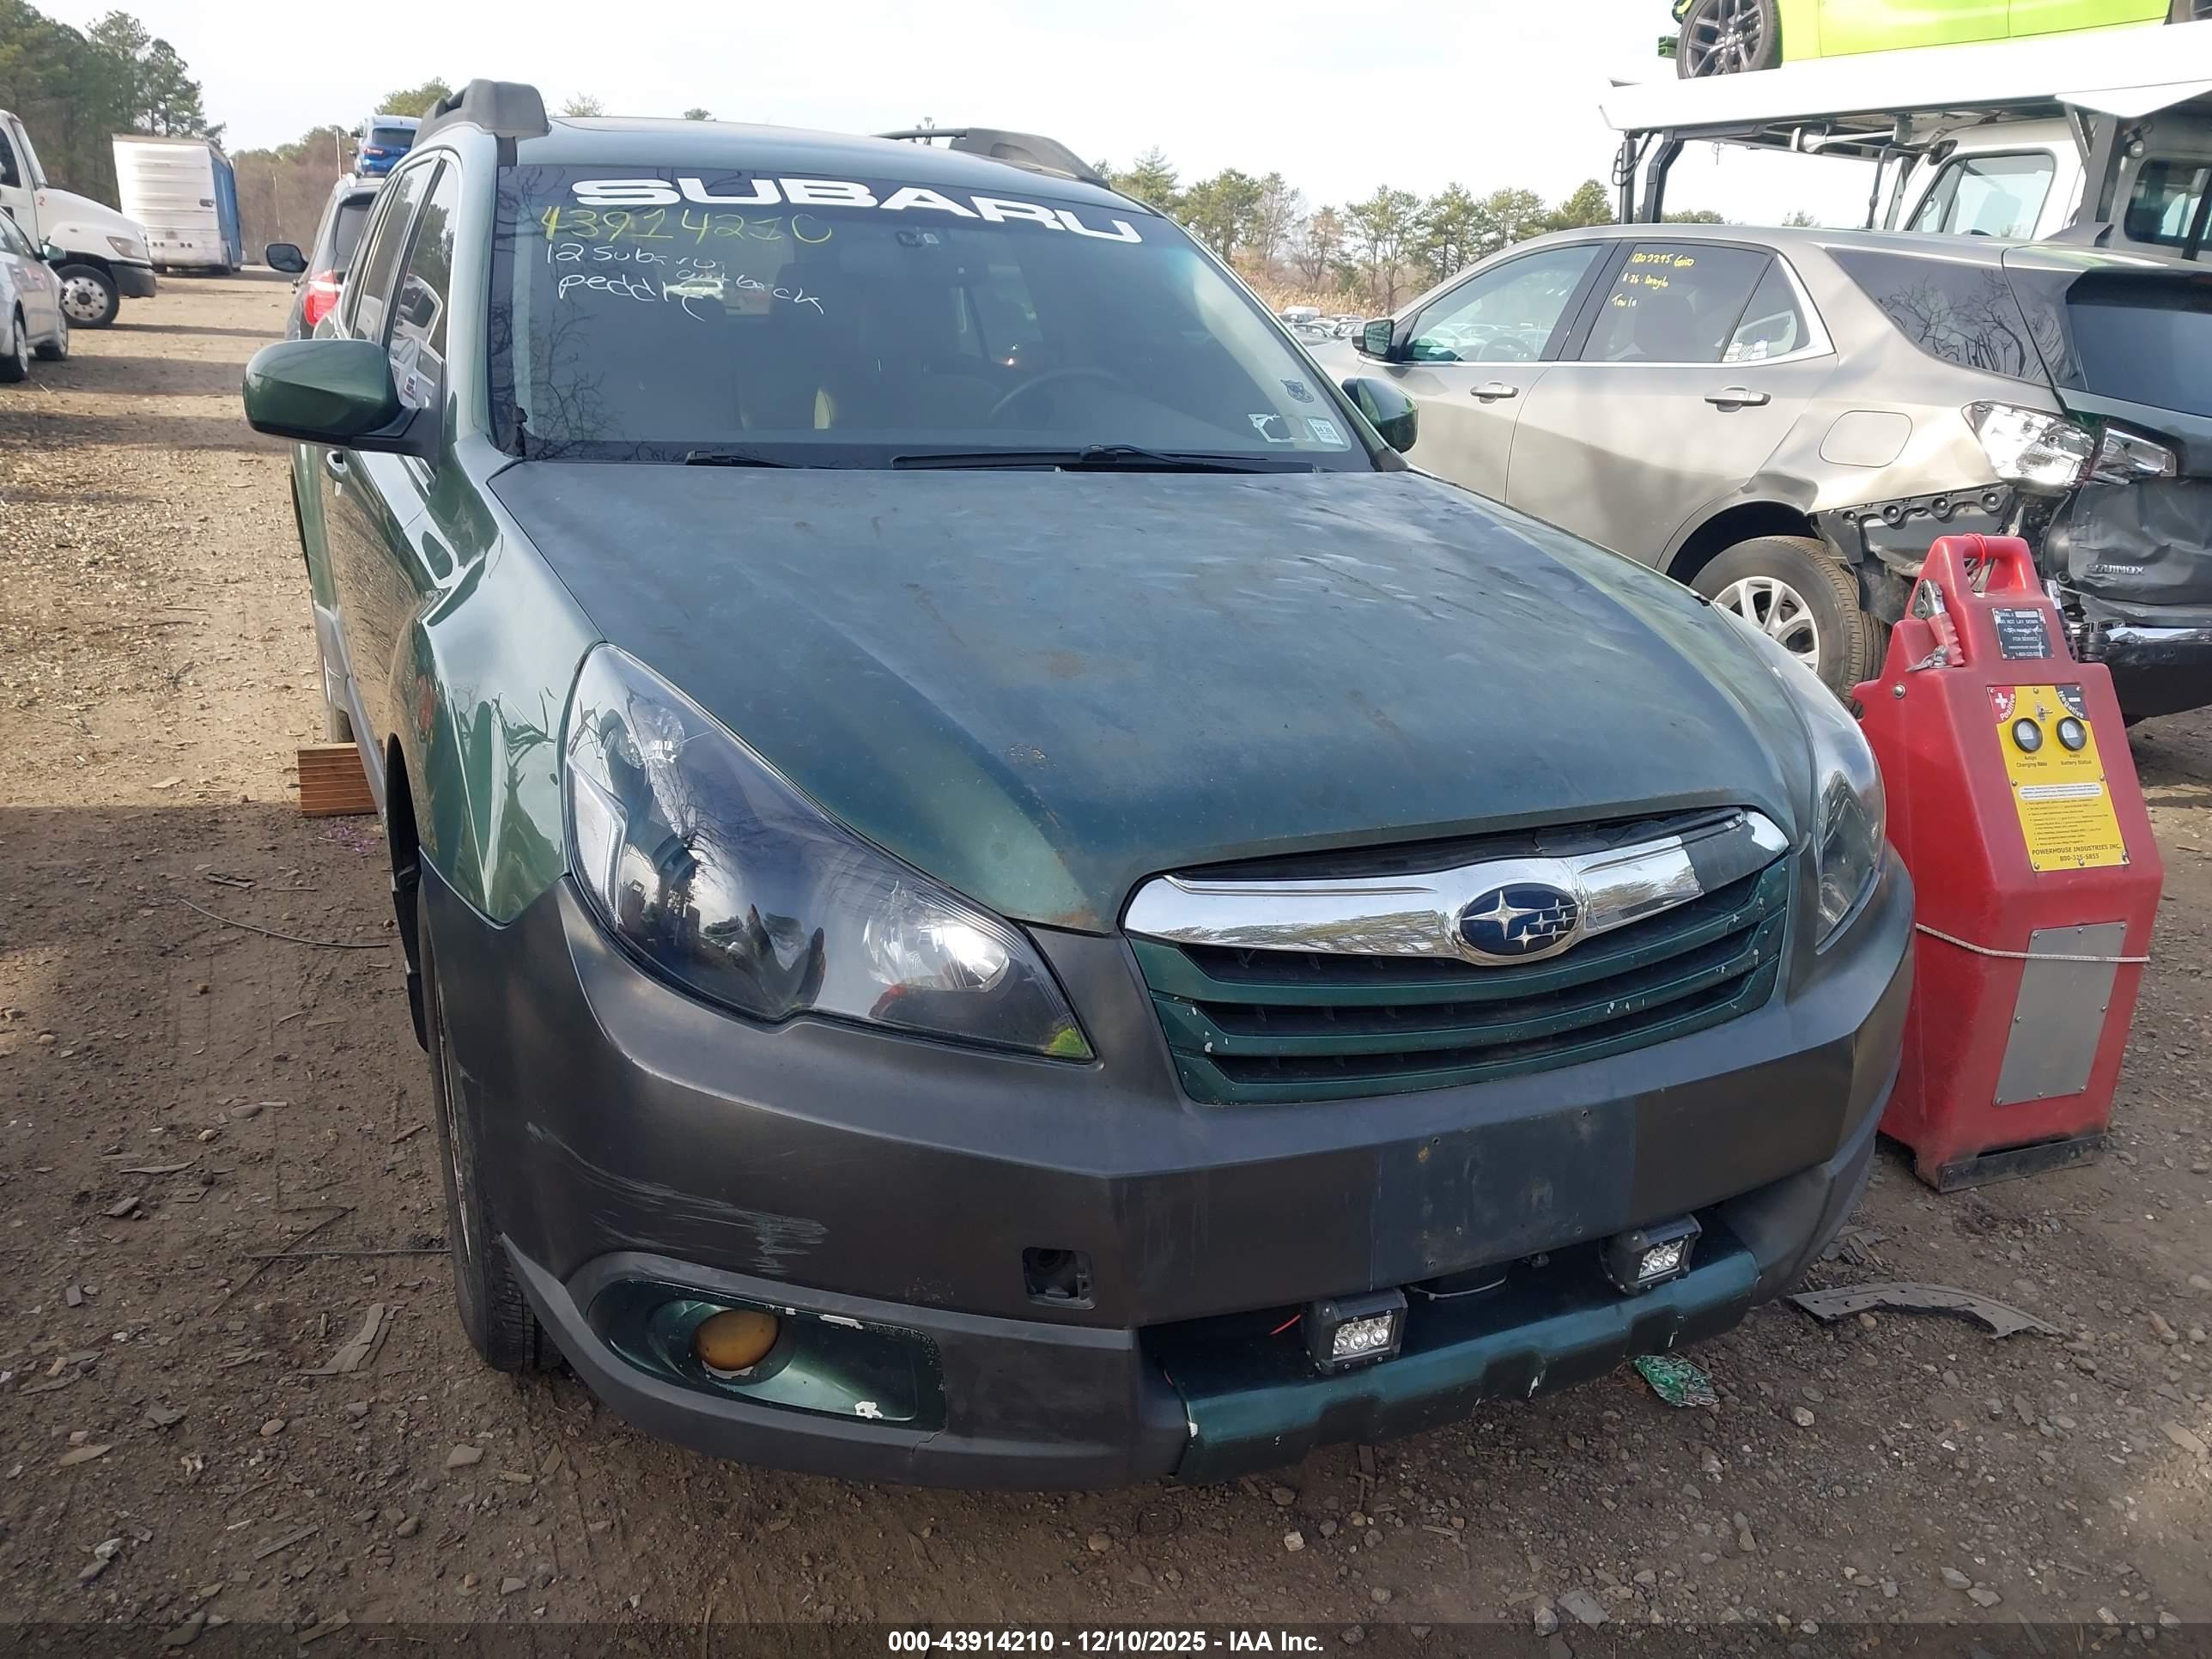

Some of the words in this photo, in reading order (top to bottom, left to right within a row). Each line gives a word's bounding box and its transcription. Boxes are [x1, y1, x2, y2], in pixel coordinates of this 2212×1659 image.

[540, 206, 833, 245] 43914210
[571, 178, 1143, 244] SUBARU
[1999, 693, 2016, 721] Positive
[2057, 690, 2085, 719] Negative
[2032, 847, 2072, 855] POWERHOUSE
[2073, 844, 2108, 853] INDUSTRIES
